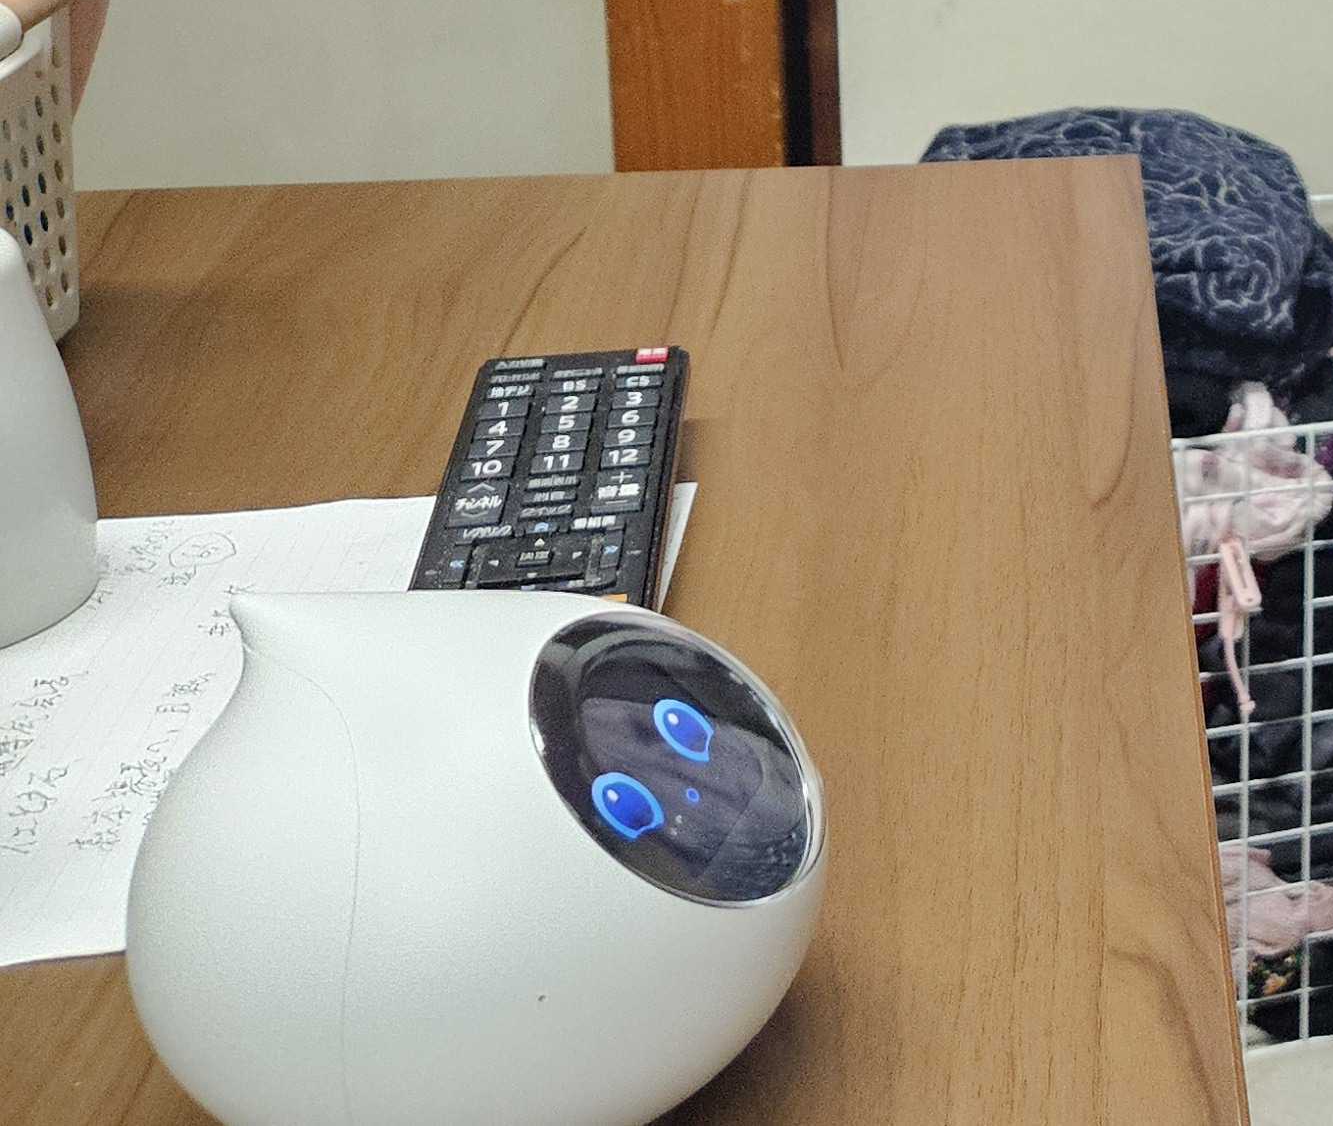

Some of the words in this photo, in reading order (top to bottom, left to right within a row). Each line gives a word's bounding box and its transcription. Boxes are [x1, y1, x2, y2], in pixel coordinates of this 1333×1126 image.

[562, 380, 587, 392] BS
[626, 376, 650, 388] CS
[498, 401, 509, 417] 1
[561, 396, 580, 411] 2
[625, 392, 643, 406] 3
[488, 420, 508, 436] 4
[558, 415, 575, 431] 5
[621, 410, 640, 424] 6
[486, 440, 505, 456] 7
[552, 435, 571, 449] 8
[618, 429, 636, 444] 9
[471, 460, 502, 475] 10
[543, 454, 571, 471] 11
[608, 449, 639, 464] 12
